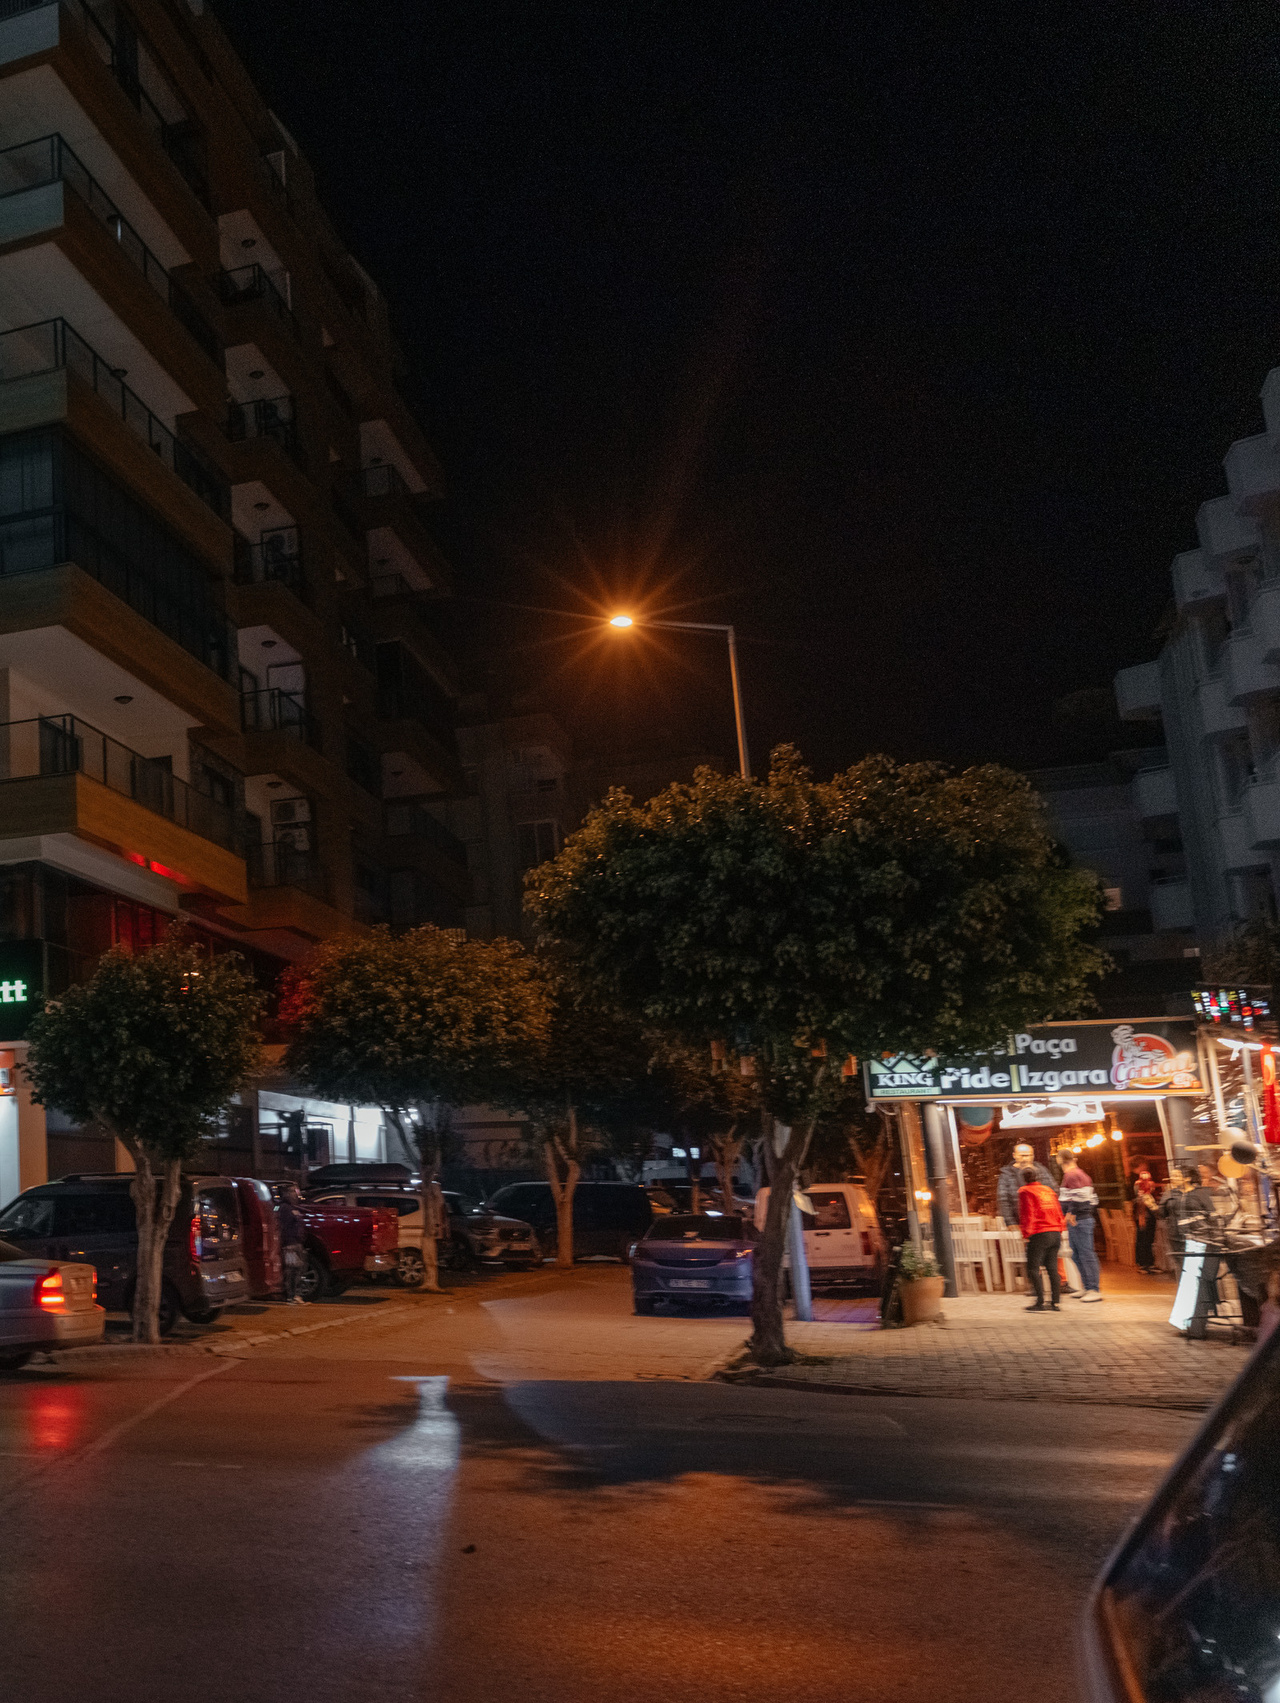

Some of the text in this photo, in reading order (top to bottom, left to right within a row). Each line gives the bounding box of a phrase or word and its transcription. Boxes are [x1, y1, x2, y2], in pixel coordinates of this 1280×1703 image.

[1015, 1033, 1078, 1059] Paça
[877, 1072, 934, 1088] KING
[940, 1064, 1109, 1091] Pide Izgara
